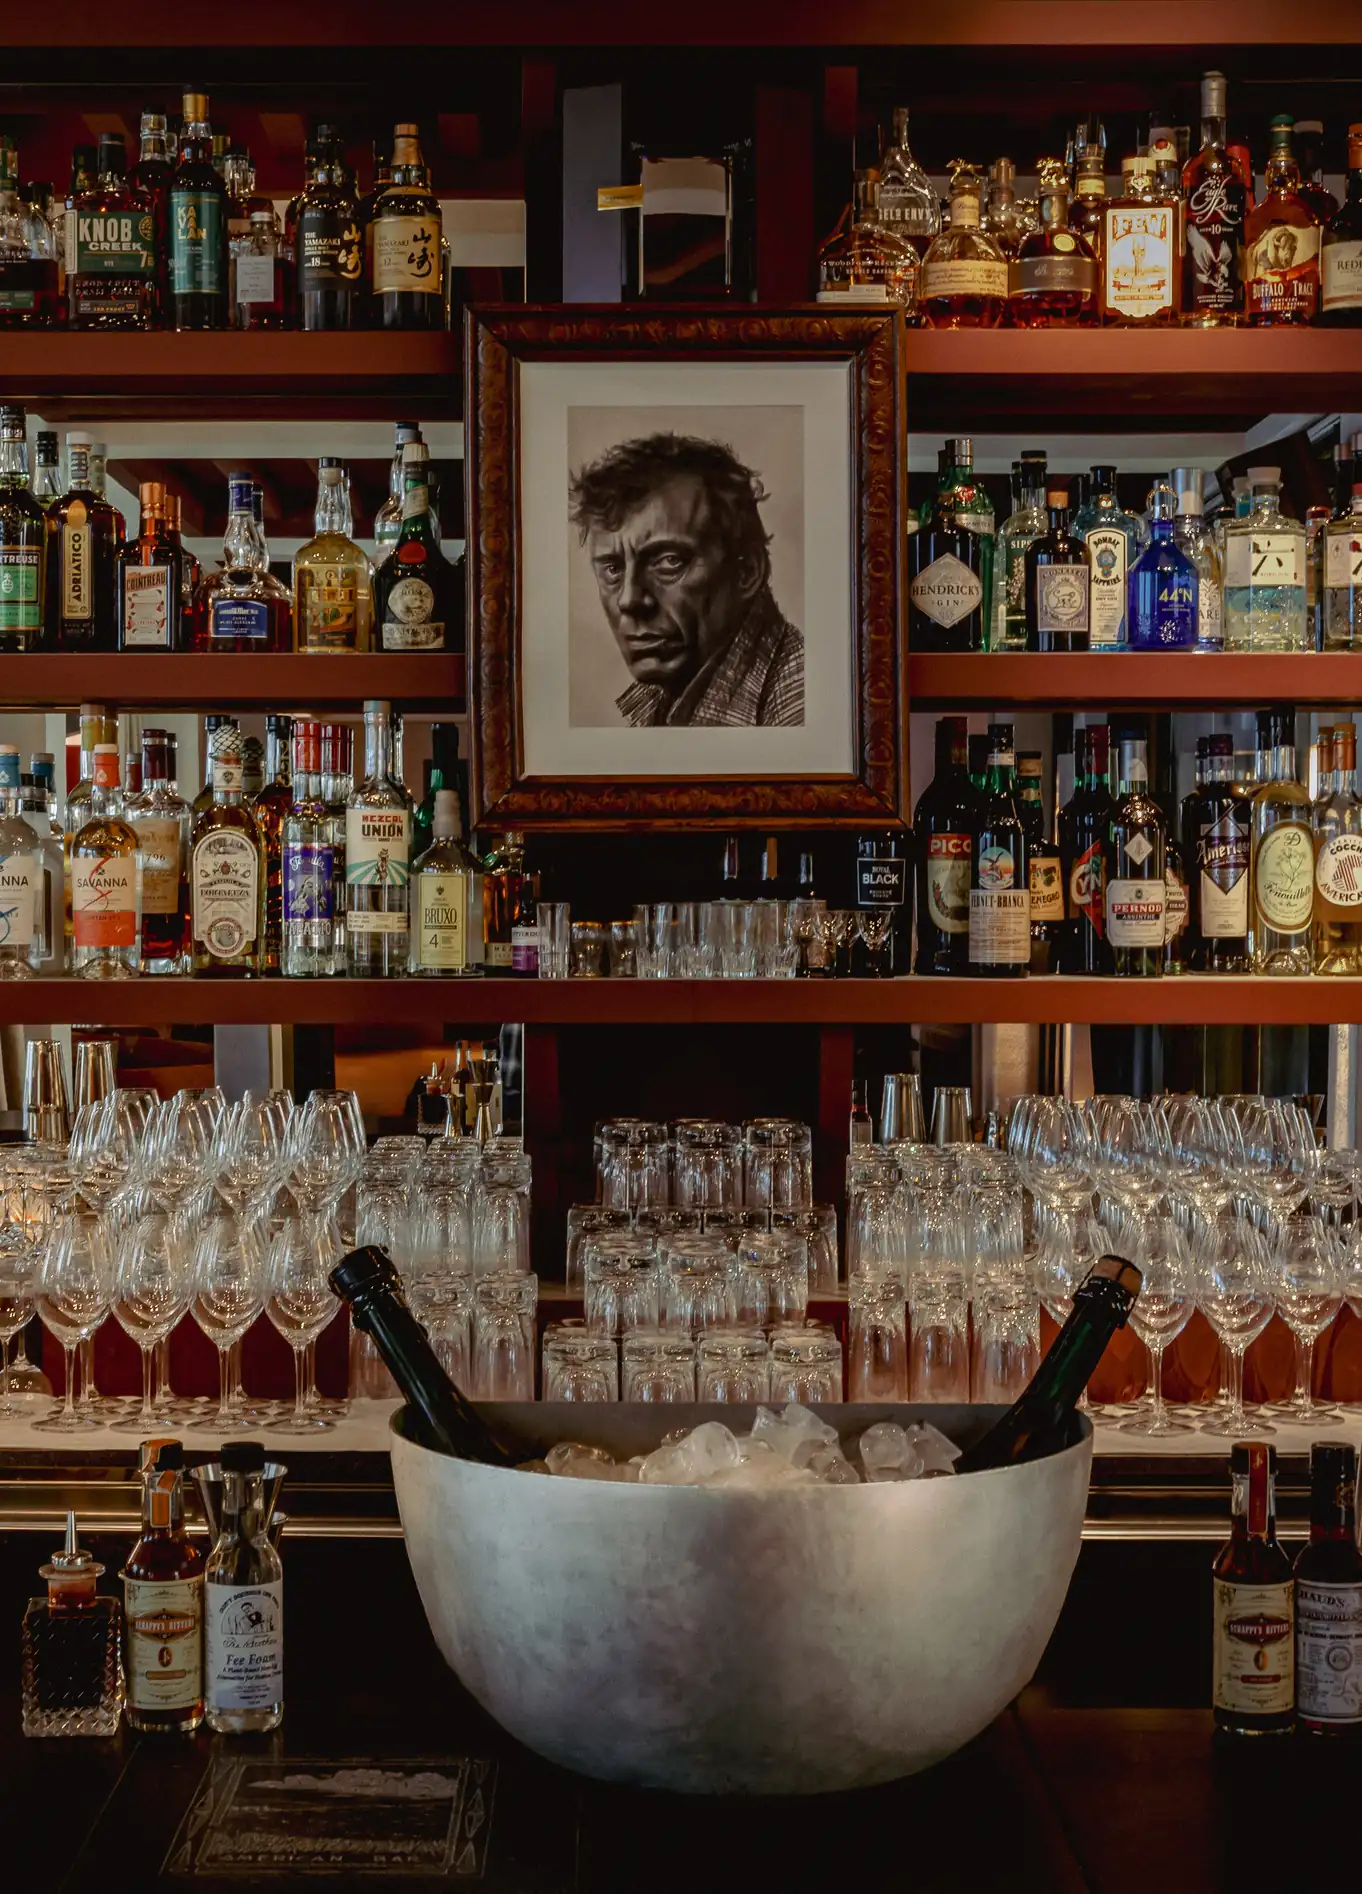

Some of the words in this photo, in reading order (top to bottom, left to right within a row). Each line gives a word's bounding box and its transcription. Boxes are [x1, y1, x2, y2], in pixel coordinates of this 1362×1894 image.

[80, 218, 132, 242] KNOB
[1113, 213, 1166, 240] FEW
[1211, 224, 1221, 235] 10
[178, 228, 207, 240] LAN
[304, 231, 316, 239] THE
[88, 242, 143, 251] CREEK
[304, 238, 340, 246] YAMAZAKI
[139, 251, 147, 268] 7
[310, 256, 321, 267] 18
[1337, 260, 1362, 270] RED
[1252, 282, 1284, 300] BUFFALO
[1292, 280, 1313, 297] TRACE
[1093, 536, 1120, 549] BOMBAY
[72, 533, 82, 602] ADRIATICO
[127, 572, 166, 590] COINTREAU
[1091, 574, 1121, 587] SAPPHIRE
[912, 585, 980, 596] HENDRICK'S
[1199, 609, 1220, 621] ARE
[362, 815, 403, 823] MEZCAL
[146, 852, 166, 862] 796
[0, 876, 29, 887] NNA
[77, 878, 128, 888] SAVANNA
[862, 873, 899, 885] BLACK
[1030, 891, 1060, 904] ENEGRO
[1113, 904, 1162, 913] PERNOD
[424, 908, 457, 924] BRUXO
[429, 934, 438, 949] 4
[226, 1654, 245, 1665] Fee
[248, 1653, 277, 1665] Foam
